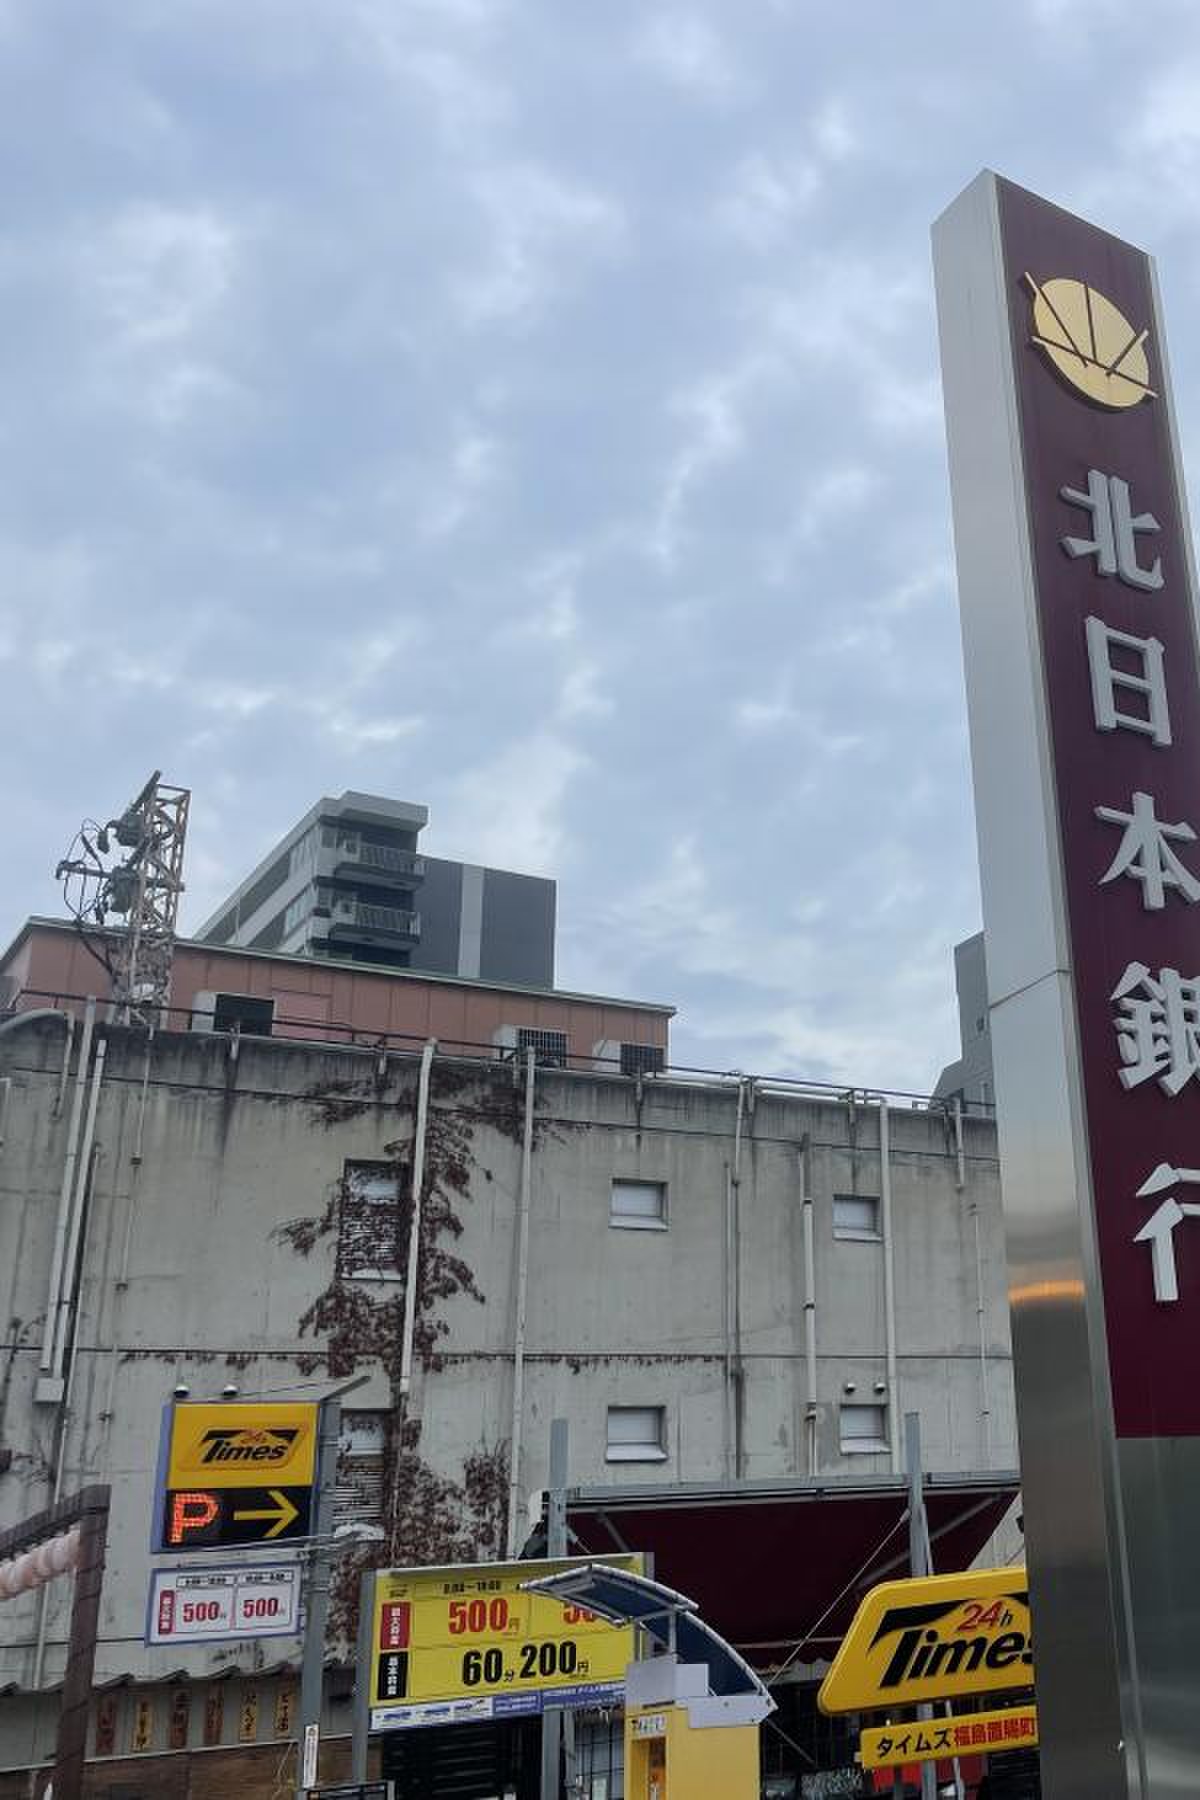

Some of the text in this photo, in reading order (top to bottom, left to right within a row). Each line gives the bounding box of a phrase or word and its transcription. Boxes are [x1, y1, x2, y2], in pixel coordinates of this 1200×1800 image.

[200, 1429, 299, 1463] Times
[170, 1492, 219, 1544] P
[957, 1600, 1013, 1633] 24h
